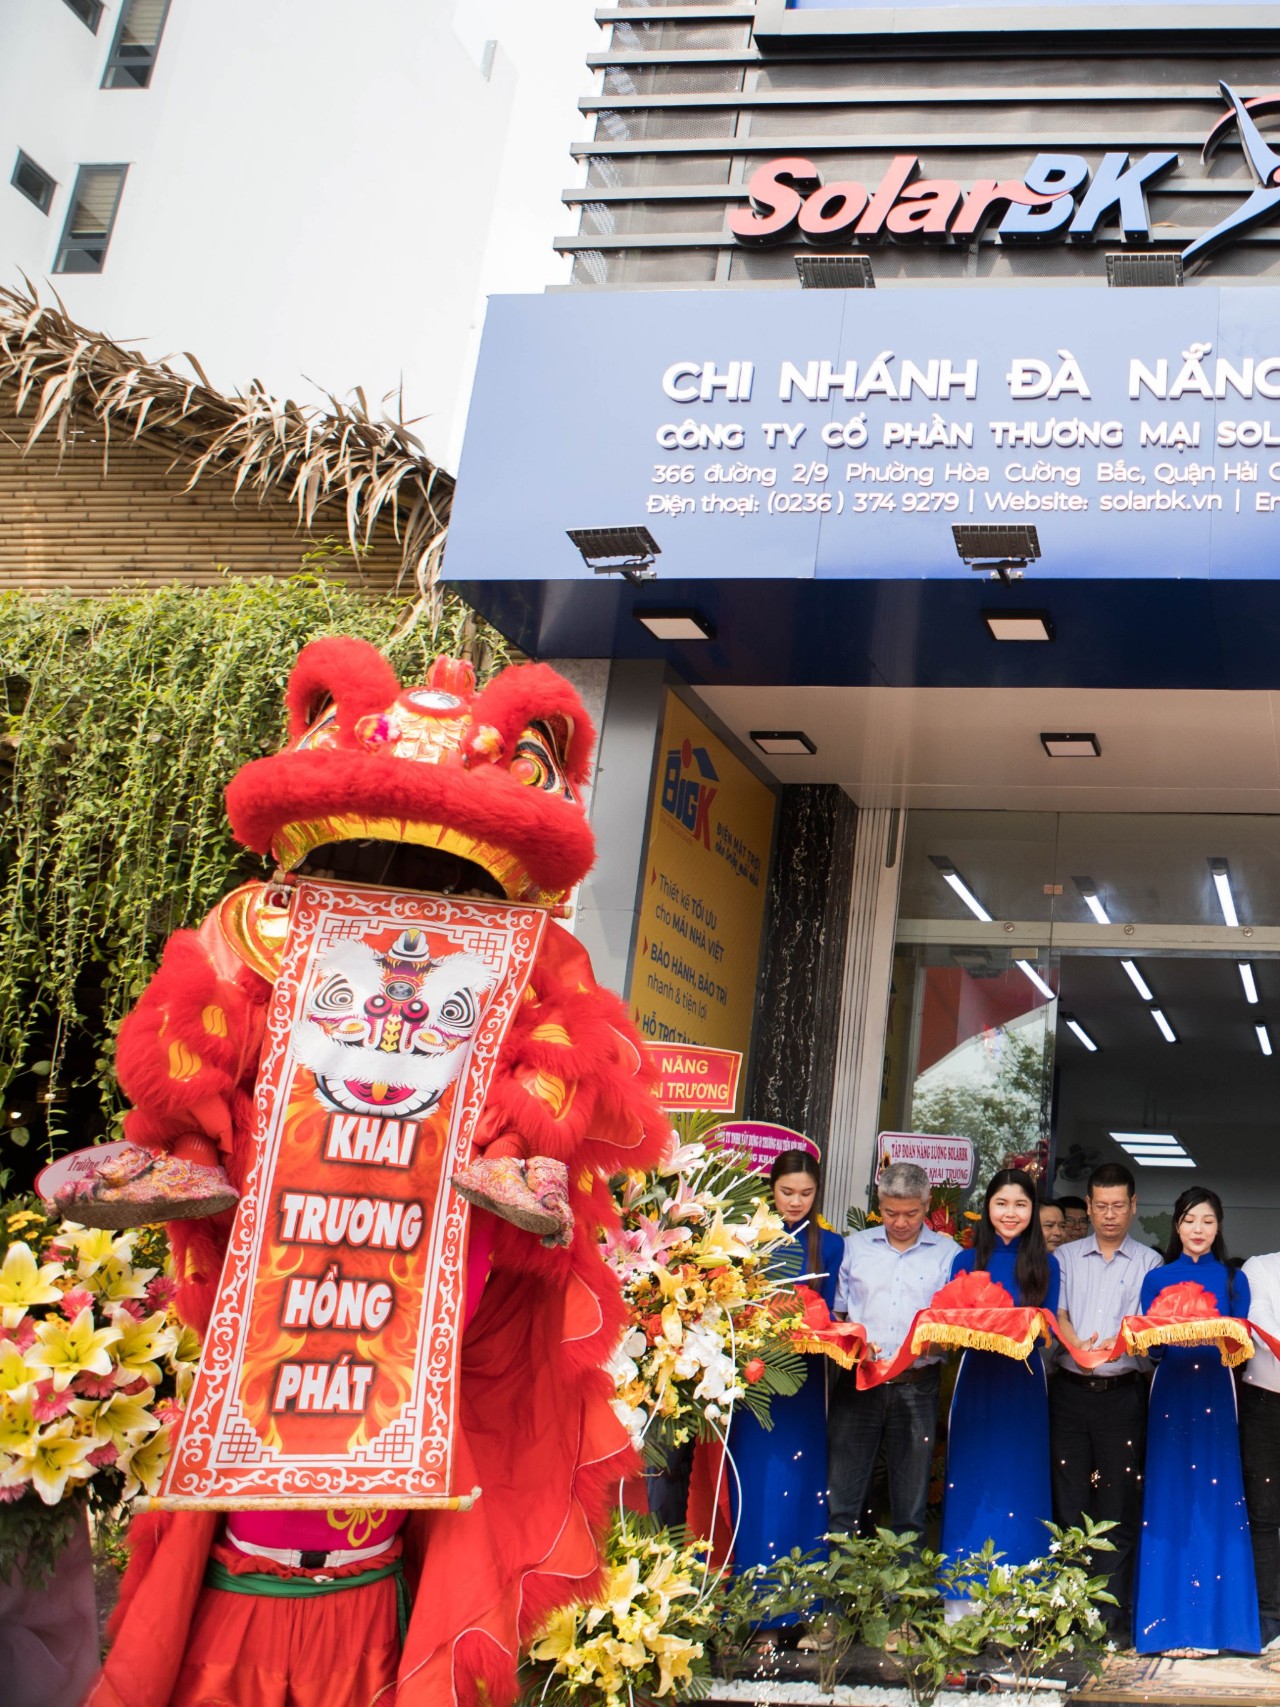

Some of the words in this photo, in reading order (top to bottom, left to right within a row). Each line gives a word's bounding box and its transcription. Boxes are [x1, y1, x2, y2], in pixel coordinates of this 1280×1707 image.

[728, 152, 1180, 243] SolarBK
[662, 361, 754, 404] CHI
[778, 350, 978, 402] NHÁNH
[1006, 349, 1091, 400] ĐÀ
[656, 418, 745, 449] CÔNG
[762, 422, 806, 449] TY
[821, 411, 868, 448] CỔ
[883, 413, 974, 449] PHẦN
[989, 417, 1123, 449] THƯƠNG
[1139, 421, 1200, 453] MẠI
[651, 464, 696, 484] 366
[704, 460, 777, 487] đường
[791, 460, 829, 485] 2/9
[845, 459, 934, 487] Phường
[944, 462, 990, 483] Hòa
[1004, 460, 1081, 486] Cường
[1097, 459, 1146, 484] Bắc,
[1154, 462, 1216, 486] Quận
[1223, 460, 1258, 483] Hải
[646, 494, 696, 518] Điện
[701, 494, 760, 518] thoại:
[852, 492, 896, 513] 374
[902, 492, 960, 513] 9279
[984, 490, 1089, 513] Website:
[1099, 489, 1223, 512] solarbk.vn
[660, 872, 680, 904] Thiết
[681, 889, 691, 911] kế
[692, 898, 705, 922] TỐI
[655, 902, 671, 926] cho
[672, 912, 689, 938] MÁI
[689, 924, 706, 951] NHÀ
[708, 937, 725, 964] VIỆT
[647, 972, 674, 1001] nhanh
[675, 987, 681, 1005] &
[682, 991, 697, 1016] tiện
[698, 1000, 708, 1024] lợi
[650, 940, 670, 969] BẢO
[671, 955, 697, 990] HÀNH,
[697, 971, 715, 998] BẢO
[715, 983, 728, 1006] TRÌ
[642, 1010, 657, 1036] HỖ
[666, 1082, 729, 1101] TRƯƠNG
[327, 1114, 418, 1167] KHAI
[928, 1167, 944, 1181] KHAI
[282, 1193, 424, 1249] TRƯƠNG
[284, 1264, 393, 1329] HỒNG
[274, 1355, 373, 1412] PHÁT
